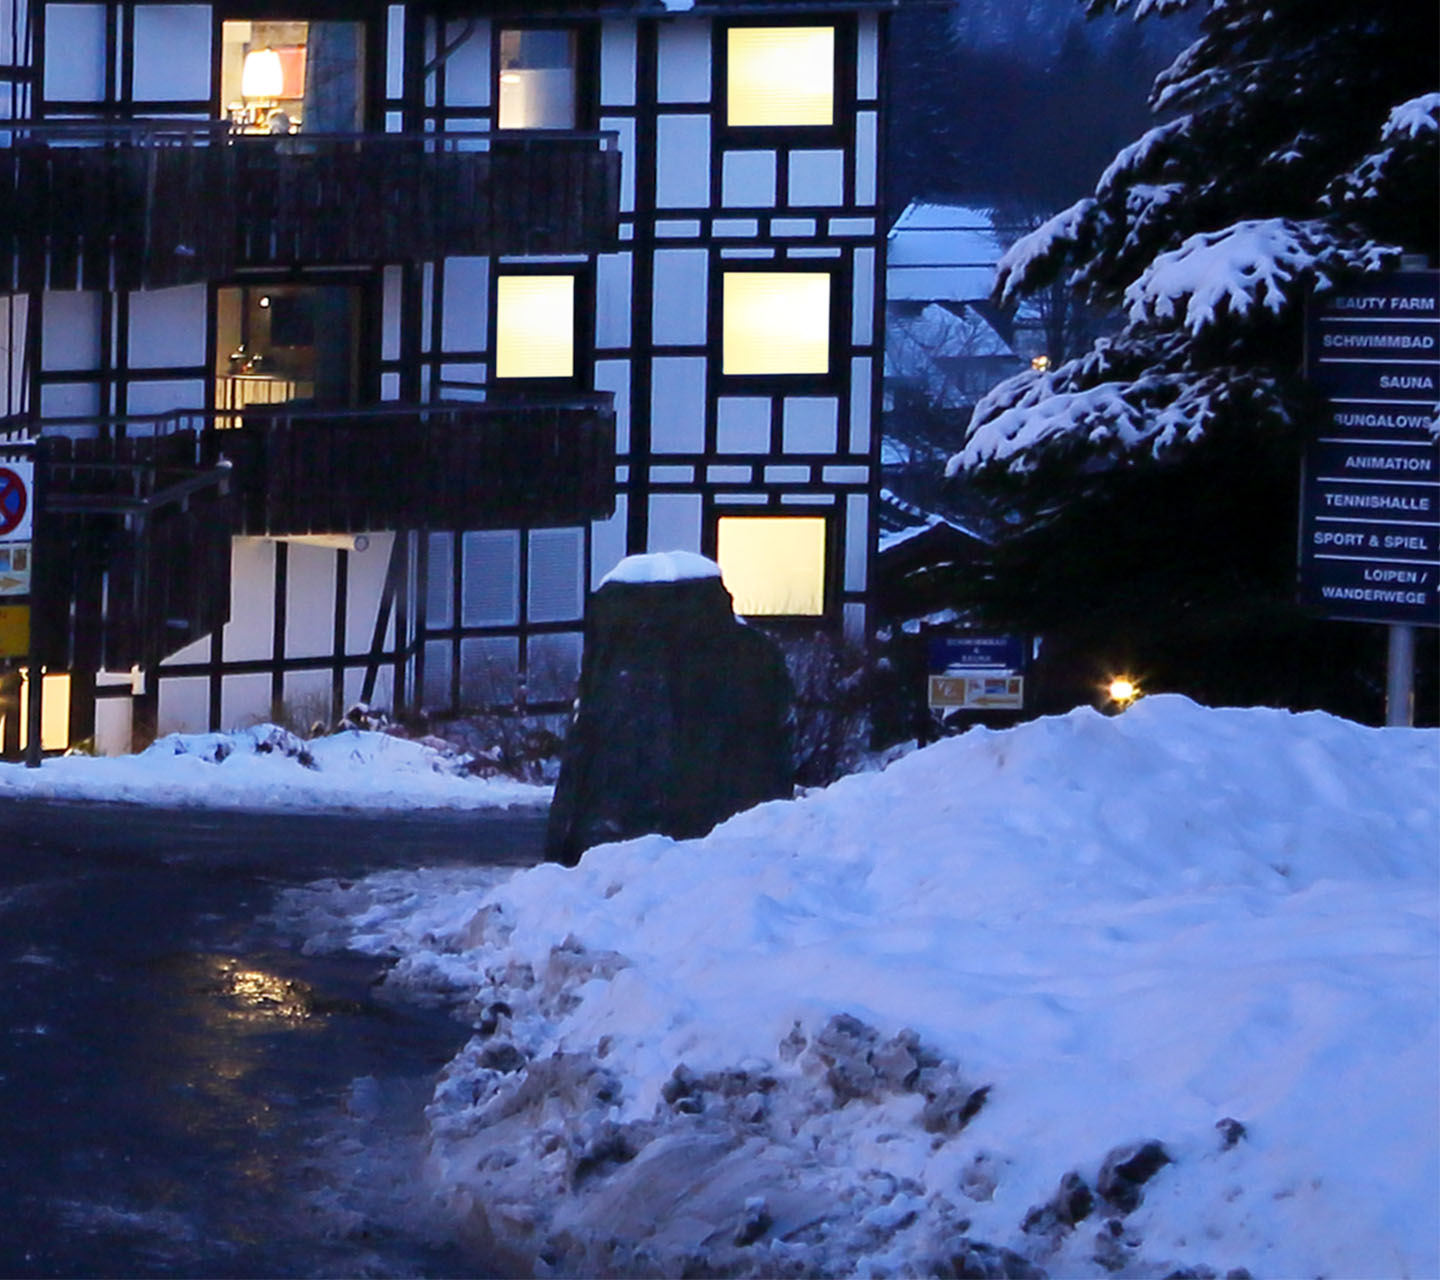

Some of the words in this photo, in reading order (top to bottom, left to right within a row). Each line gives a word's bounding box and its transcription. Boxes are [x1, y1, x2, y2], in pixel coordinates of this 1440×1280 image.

[1332, 297, 1386, 310] EAUTY
[1390, 297, 1435, 310] FARM
[1323, 334, 1434, 349] SCHWIMMBAD
[1379, 375, 1433, 389] SAUNA
[1345, 456, 1431, 471] ANIMATION
[1325, 493, 1430, 510] TENNISHALLE
[1313, 531, 1364, 546] SPORT
[1368, 535, 1379, 548] &
[1384, 535, 1428, 550] SPIEL
[1364, 569, 1416, 584] LOIPEN
[1322, 586, 1426, 605] WANDERWEGE
